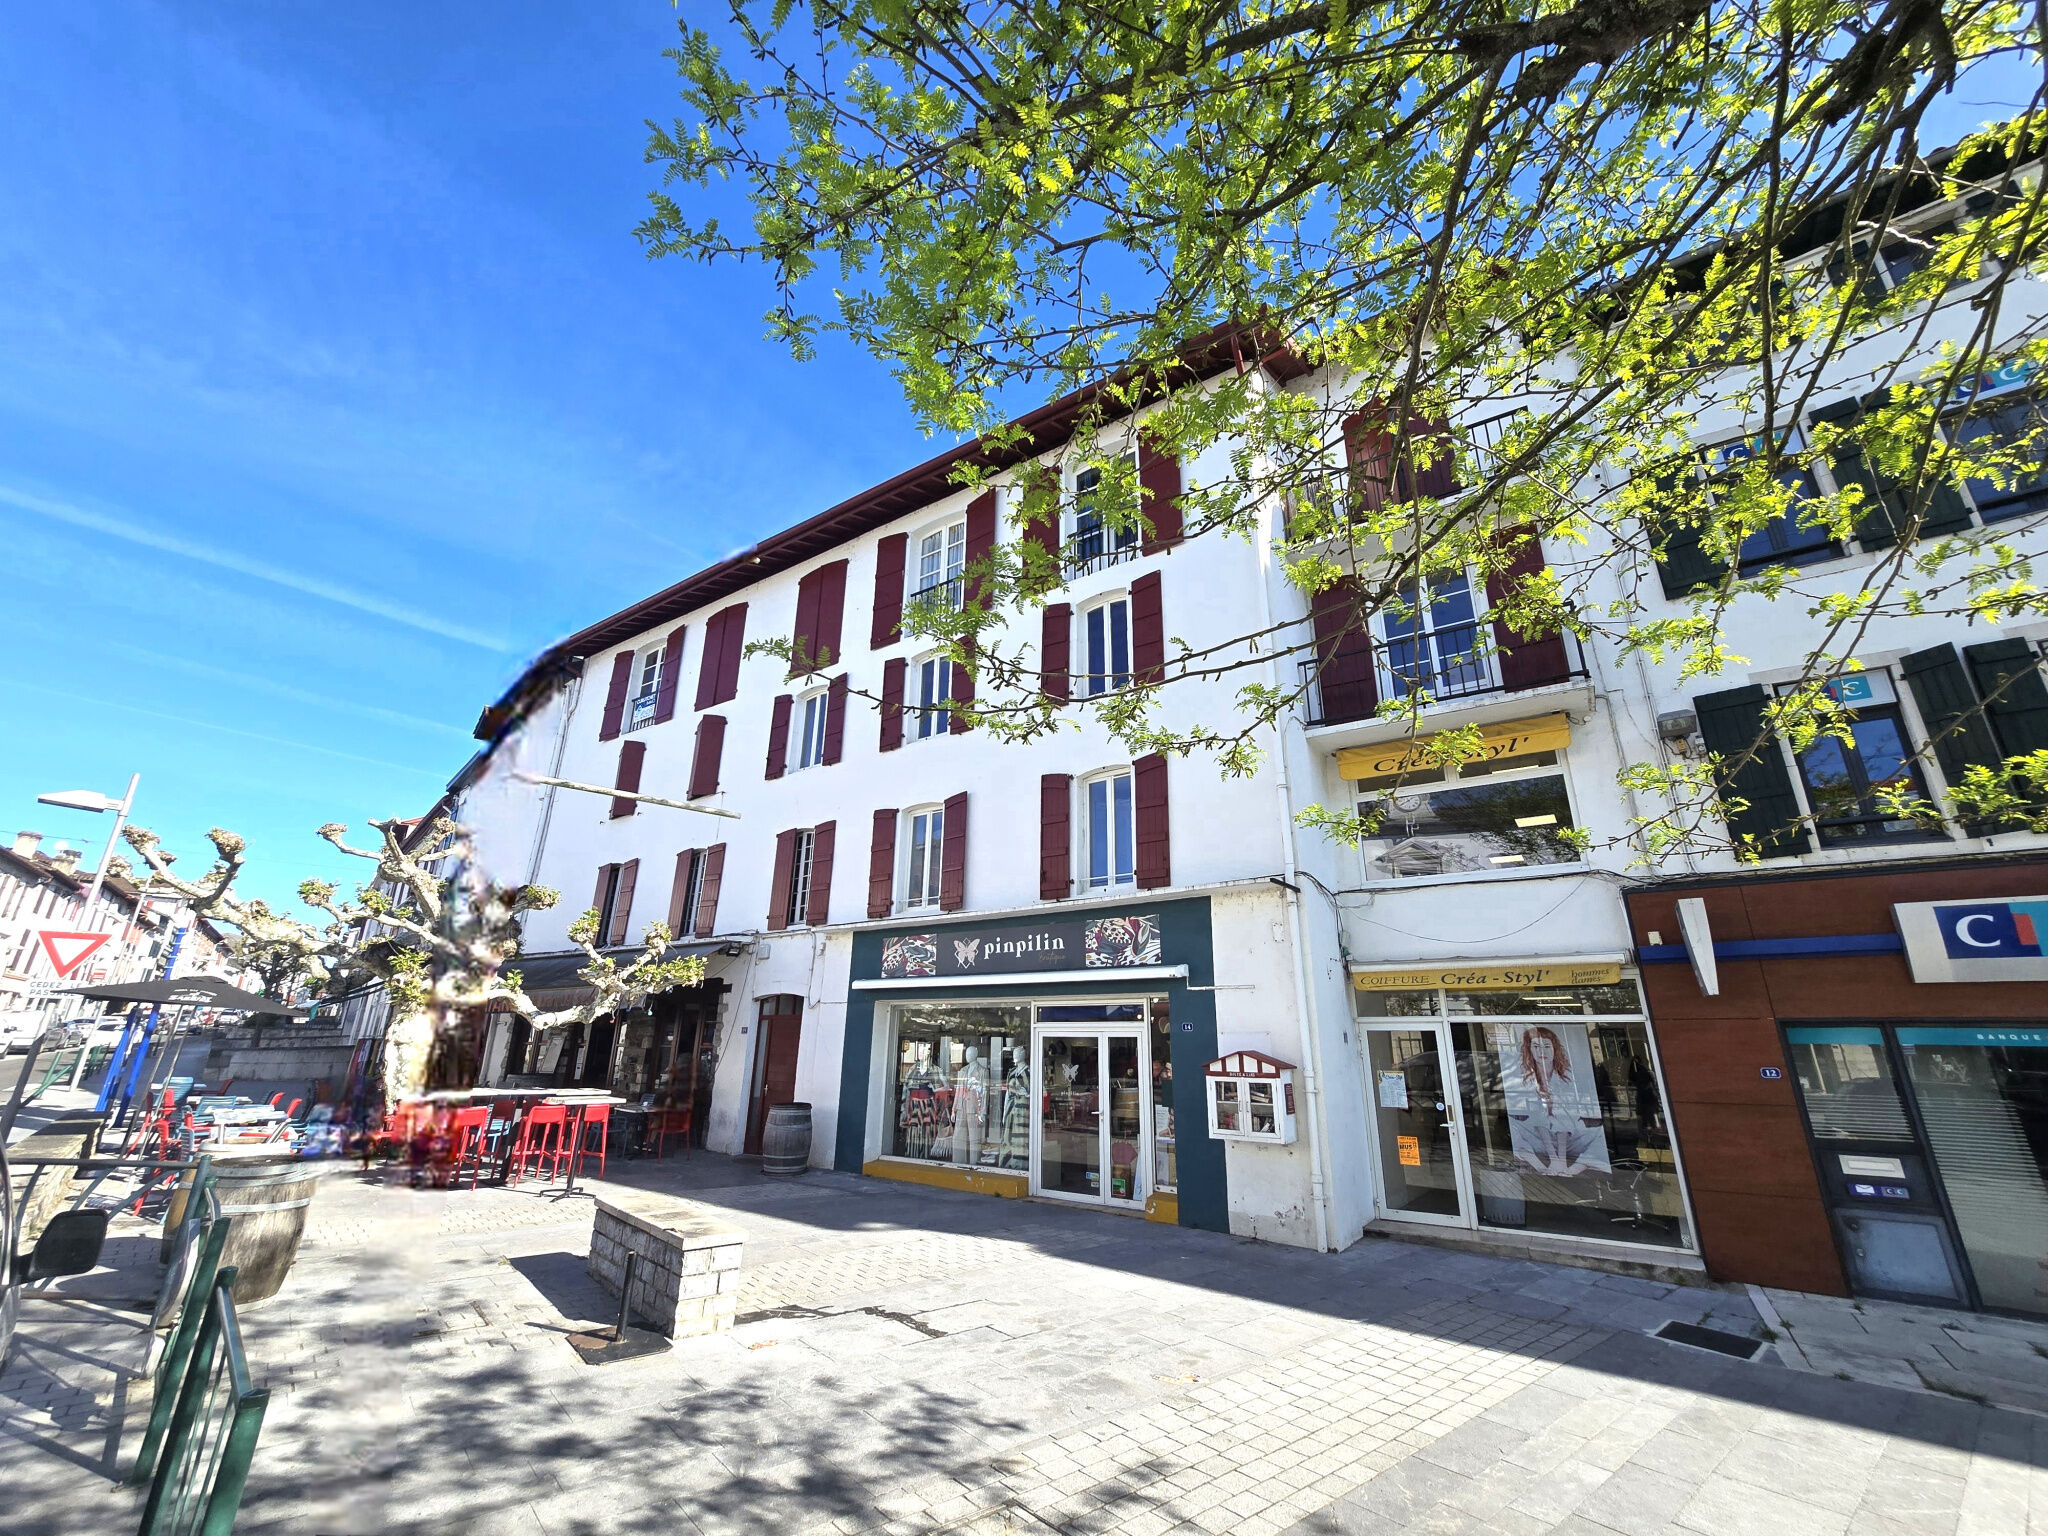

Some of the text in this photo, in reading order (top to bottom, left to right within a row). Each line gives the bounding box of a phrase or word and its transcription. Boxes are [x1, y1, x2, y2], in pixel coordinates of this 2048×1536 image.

[983, 932, 1065, 960] pinpilin
[1360, 975, 1430, 985] COIFFURE
[1440, 972, 1487, 985] Créa
[1502, 969, 1550, 986] Styl'
[1976, 1033, 2042, 1041] BANQUE
[1764, 1069, 1778, 1077] 12
